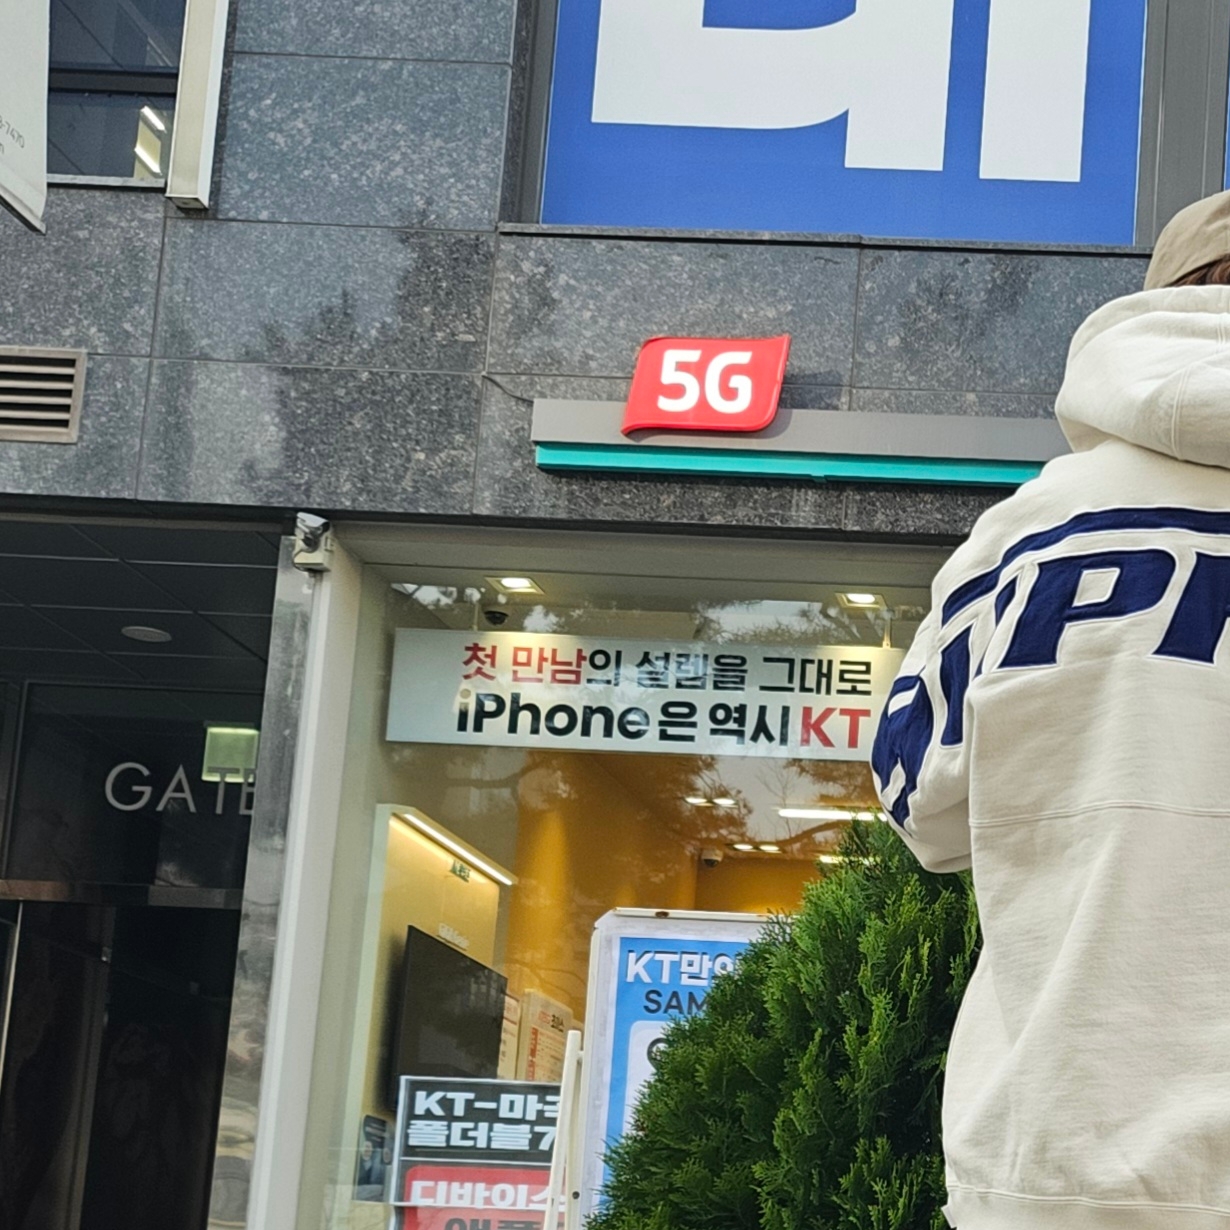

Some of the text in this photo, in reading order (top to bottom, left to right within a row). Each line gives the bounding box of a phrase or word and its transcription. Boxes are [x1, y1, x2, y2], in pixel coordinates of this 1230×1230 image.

[656, 349, 753, 415] 5G
[462, 642, 873, 697] 첫 만남의 설렘을 그대로
[799, 706, 872, 750] KT
[625, 950, 742, 987] KT만
